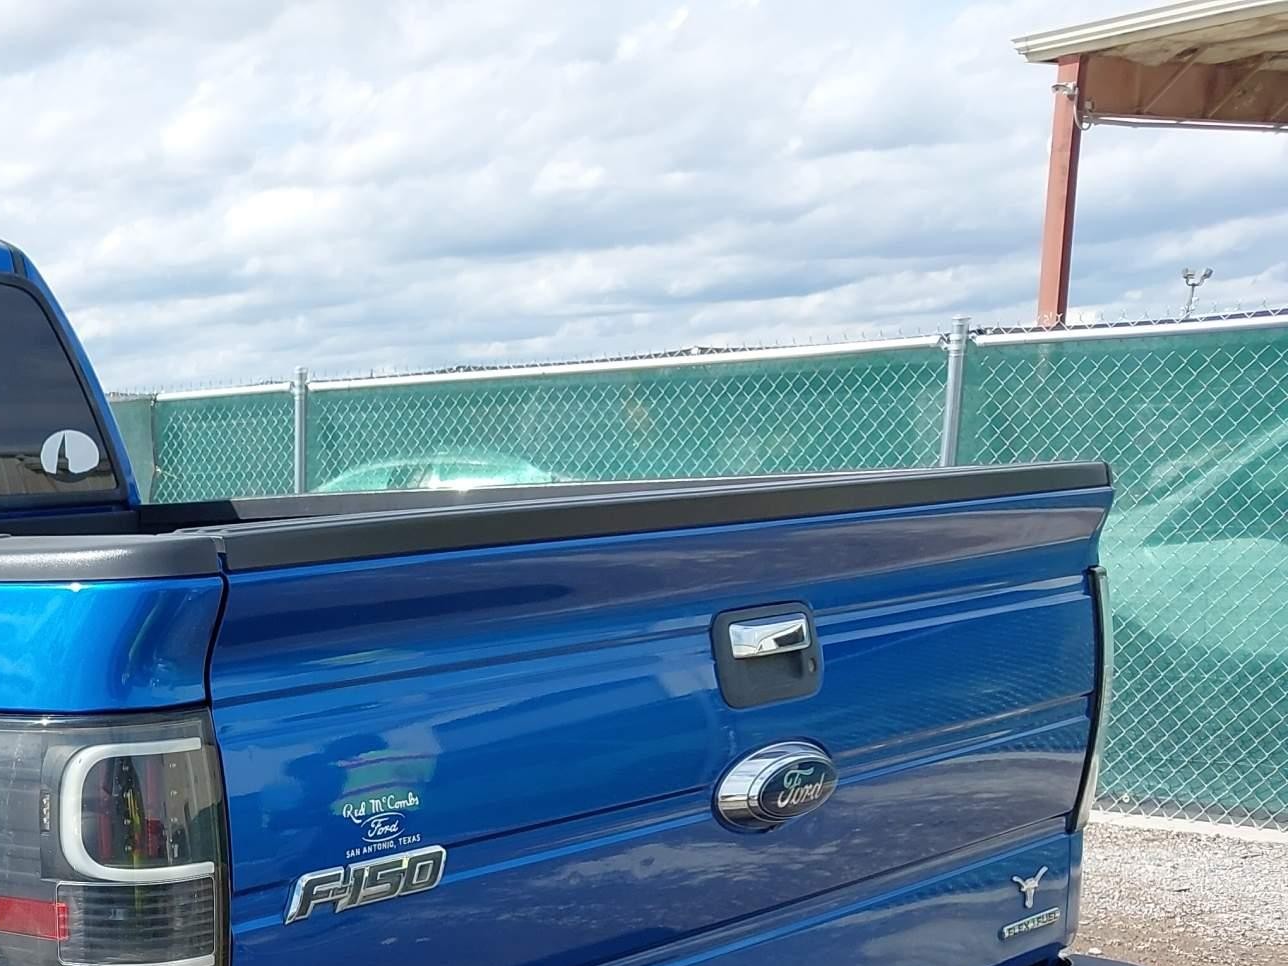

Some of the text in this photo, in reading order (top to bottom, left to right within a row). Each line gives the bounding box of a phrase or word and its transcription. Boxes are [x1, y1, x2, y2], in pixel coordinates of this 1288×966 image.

[776, 767, 825, 808] Ford
[342, 804, 366, 824] Red
[367, 817, 399, 838] Ford
[345, 834, 421, 859] SAN ANTONIO, TEXAS
[283, 845, 448, 926] F-150
